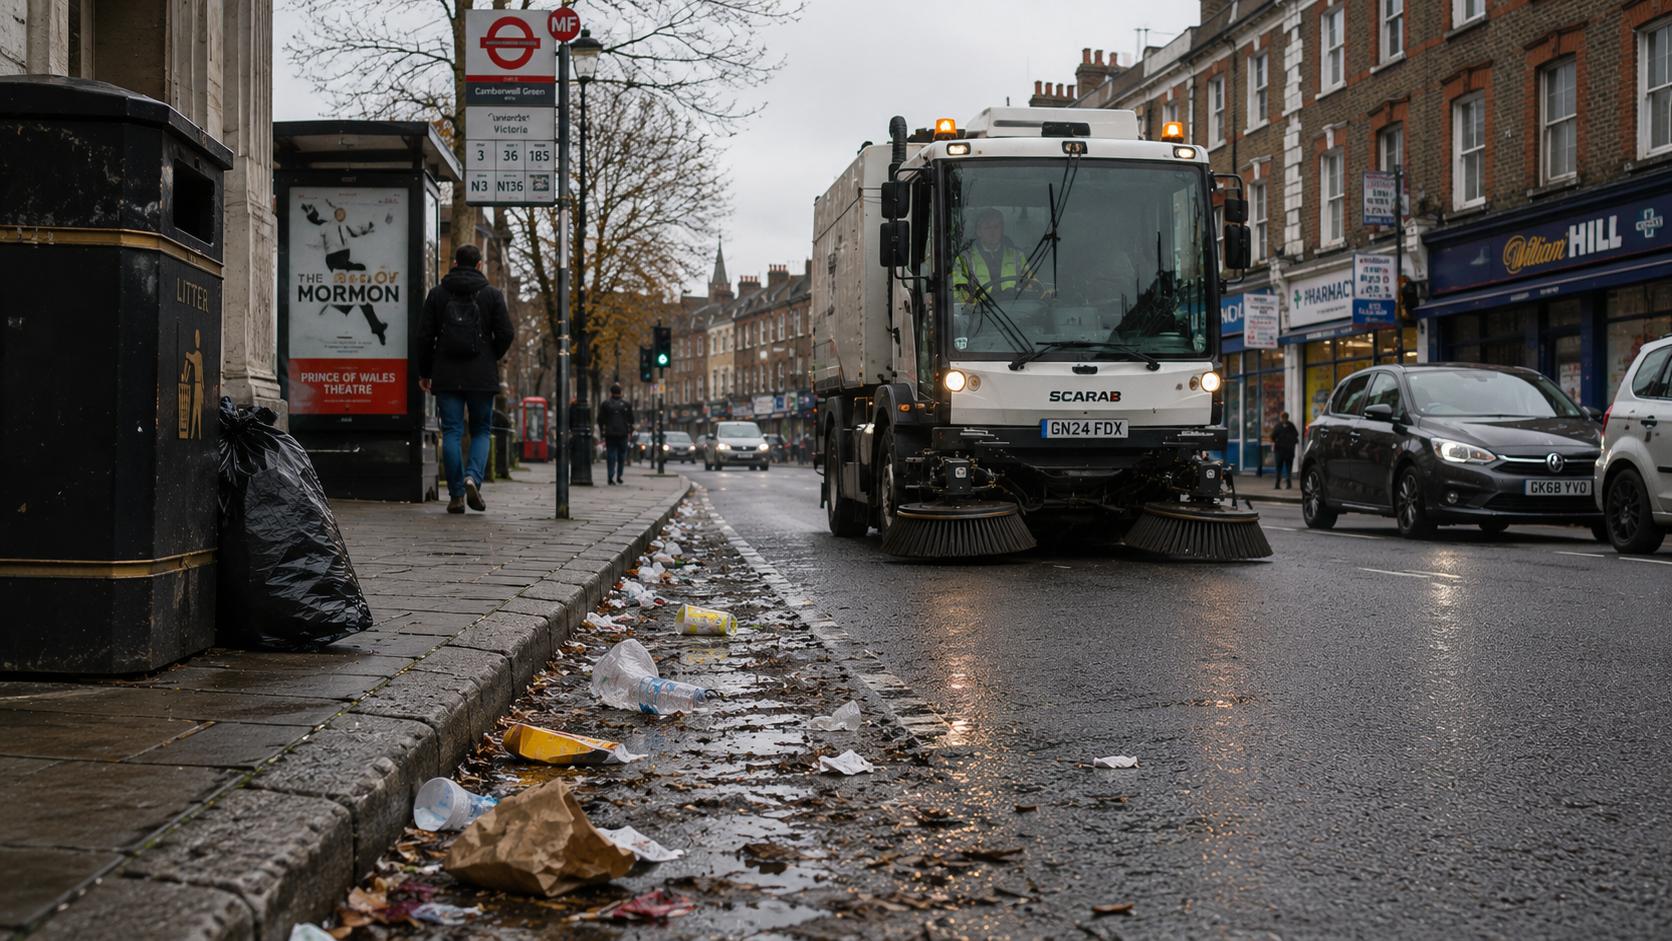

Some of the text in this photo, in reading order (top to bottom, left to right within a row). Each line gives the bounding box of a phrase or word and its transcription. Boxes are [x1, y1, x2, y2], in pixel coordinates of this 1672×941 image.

[551, 16, 577, 33] MF
[522, 87, 546, 95] Green
[477, 150, 485, 161] 3
[503, 150, 518, 161] 36
[529, 150, 550, 162] 185
[471, 181, 489, 192] N3
[497, 181, 524, 192] N136
[1503, 235, 1568, 275] William
[1568, 215, 1623, 258] HILL
[298, 273, 324, 283] THE
[176, 277, 209, 312] LITTER
[298, 285, 400, 302] MORMON
[300, 372, 396, 383] PRINCE OF WALES
[323, 384, 373, 395] THEATRE
[1049, 391, 1122, 402] SCARAB
[1051, 422, 1123, 435] GN24 FDX
